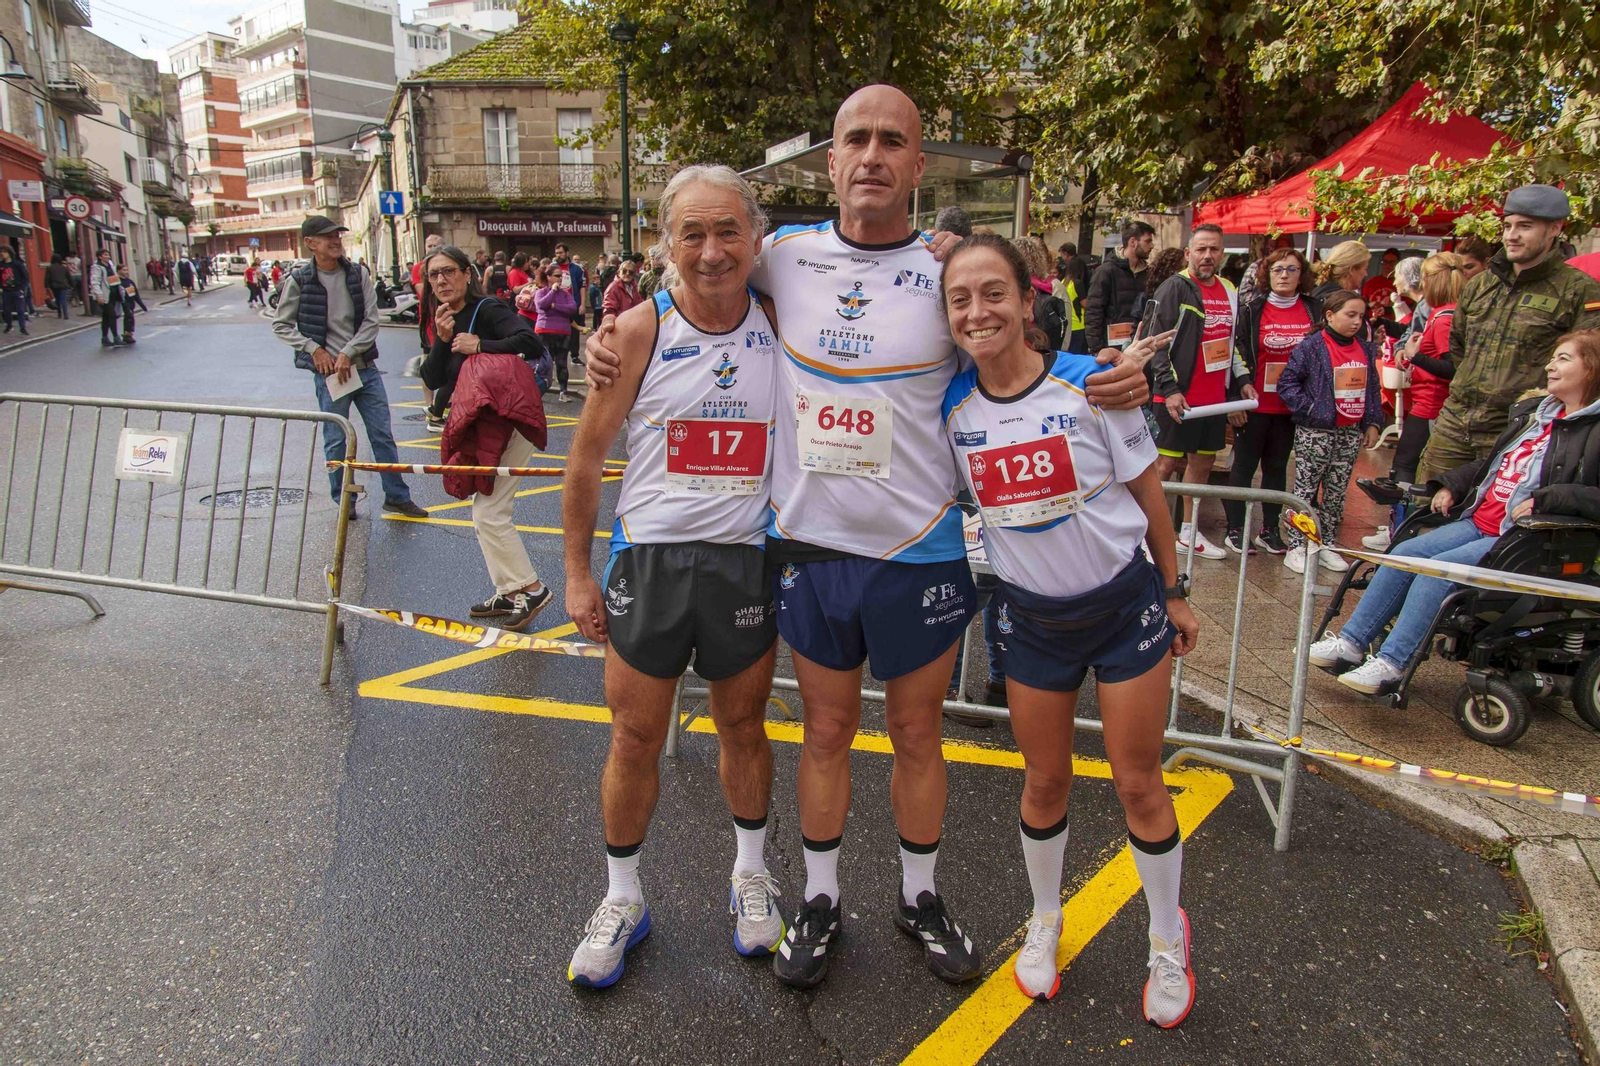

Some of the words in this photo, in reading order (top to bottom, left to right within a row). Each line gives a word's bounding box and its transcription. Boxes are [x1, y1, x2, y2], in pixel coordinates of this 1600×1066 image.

[70, 203, 87, 213] 30
[808, 261, 837, 271] HYUNDAI
[851, 257, 880, 266] NAFFTA
[904, 286, 939, 300] seguros
[820, 329, 875, 342] ATLETISMO
[673, 345, 699, 354] HYUNDAI
[818, 337, 872, 354] SAMIL
[702, 400, 748, 408] ATLETISMO
[702, 408, 746, 419] SAMIL
[818, 405, 875, 436] 648
[708, 430, 743, 455] 17
[810, 438, 825, 446] Óscar
[825, 440, 843, 448] Prieto
[843, 442, 863, 451] Araujo
[132, 445, 168, 463] TeamRelay
[686, 464, 710, 472] Enrique
[995, 450, 1055, 484] 128
[1013, 489, 1041, 500] Saborido
[1041, 486, 1051, 494] Gil
[934, 595, 964, 611] seguros
[735, 605, 764, 618] SHAVE
[938, 608, 965, 623] HYUNDAI
[735, 614, 765, 626] SAILOR
[415, 616, 485, 643] GADIS
